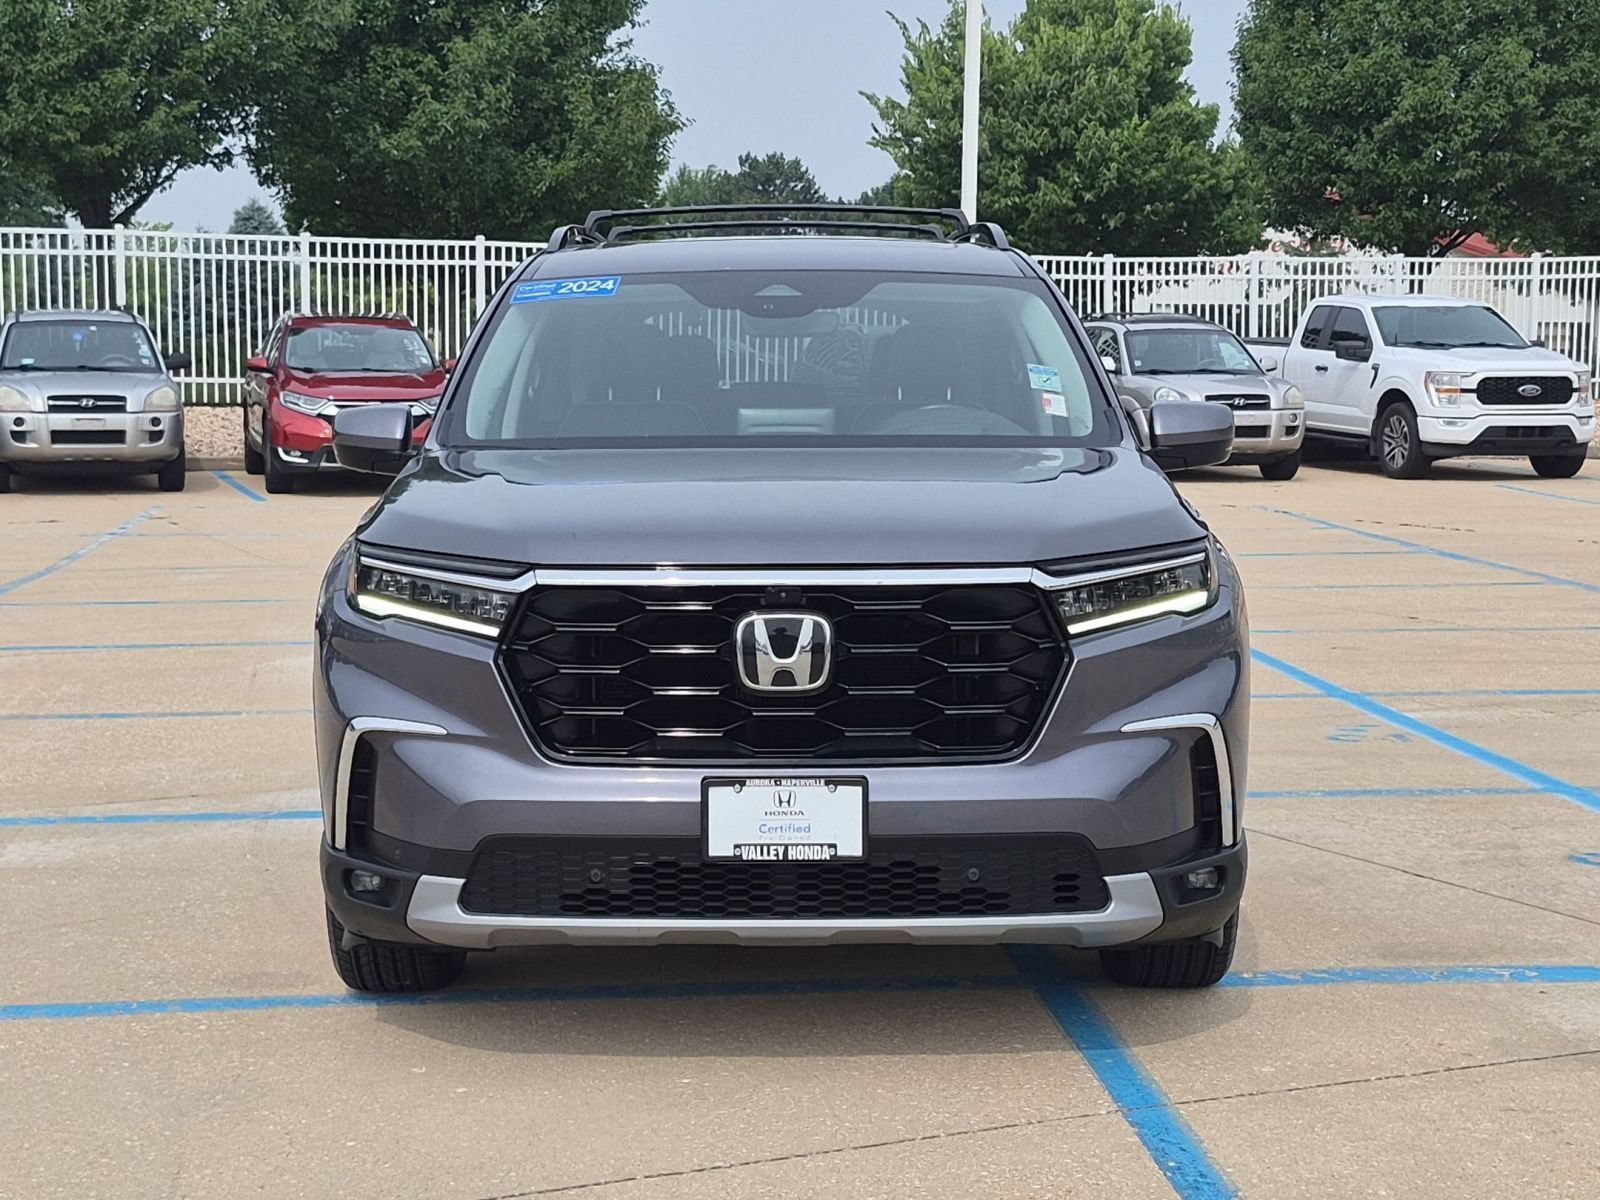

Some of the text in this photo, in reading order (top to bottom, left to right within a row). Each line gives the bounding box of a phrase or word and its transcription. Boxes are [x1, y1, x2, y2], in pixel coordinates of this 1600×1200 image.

[557, 280, 615, 294] 2024
[758, 823, 811, 834] Certified
[741, 845, 830, 860] VALLEY HONDA
